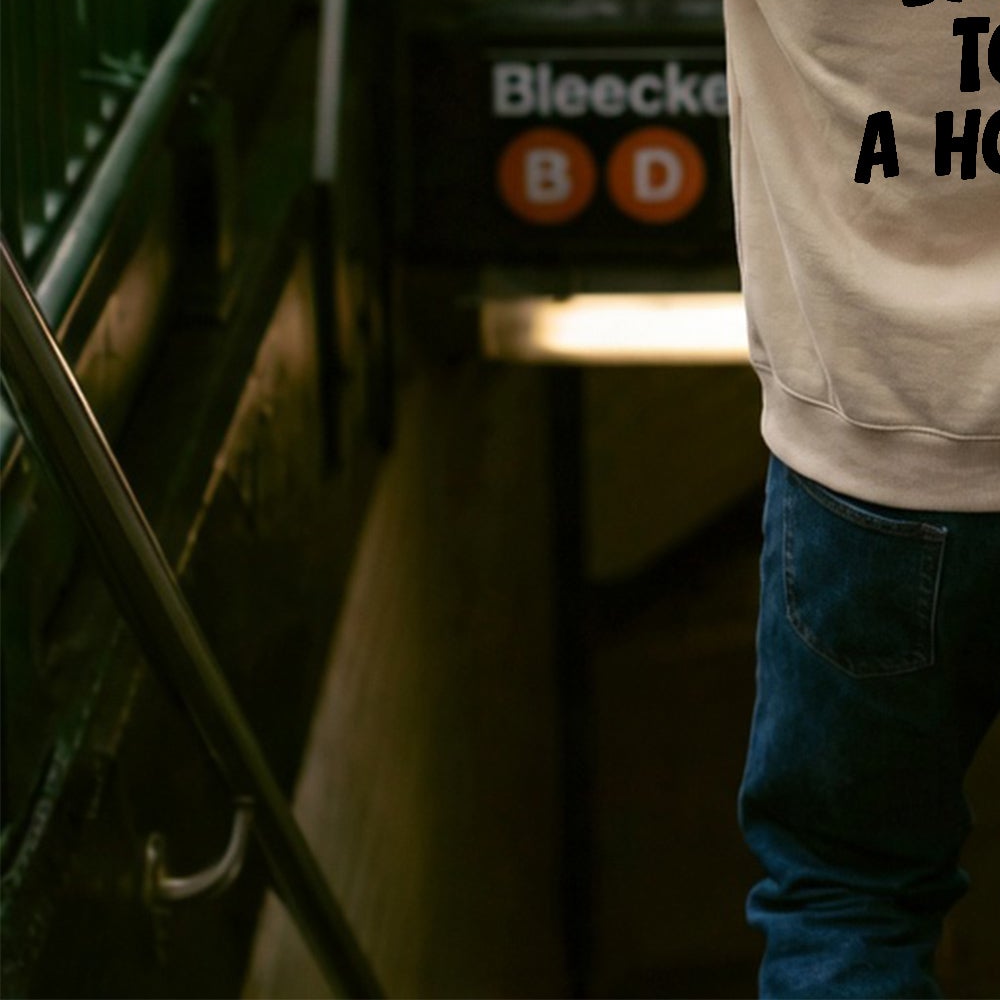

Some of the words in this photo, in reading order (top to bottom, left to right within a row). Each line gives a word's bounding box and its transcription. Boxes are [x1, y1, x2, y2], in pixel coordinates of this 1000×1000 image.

[524, 149, 571, 204] B
[633, 147, 683, 204] D
[855, 111, 899, 184] A
